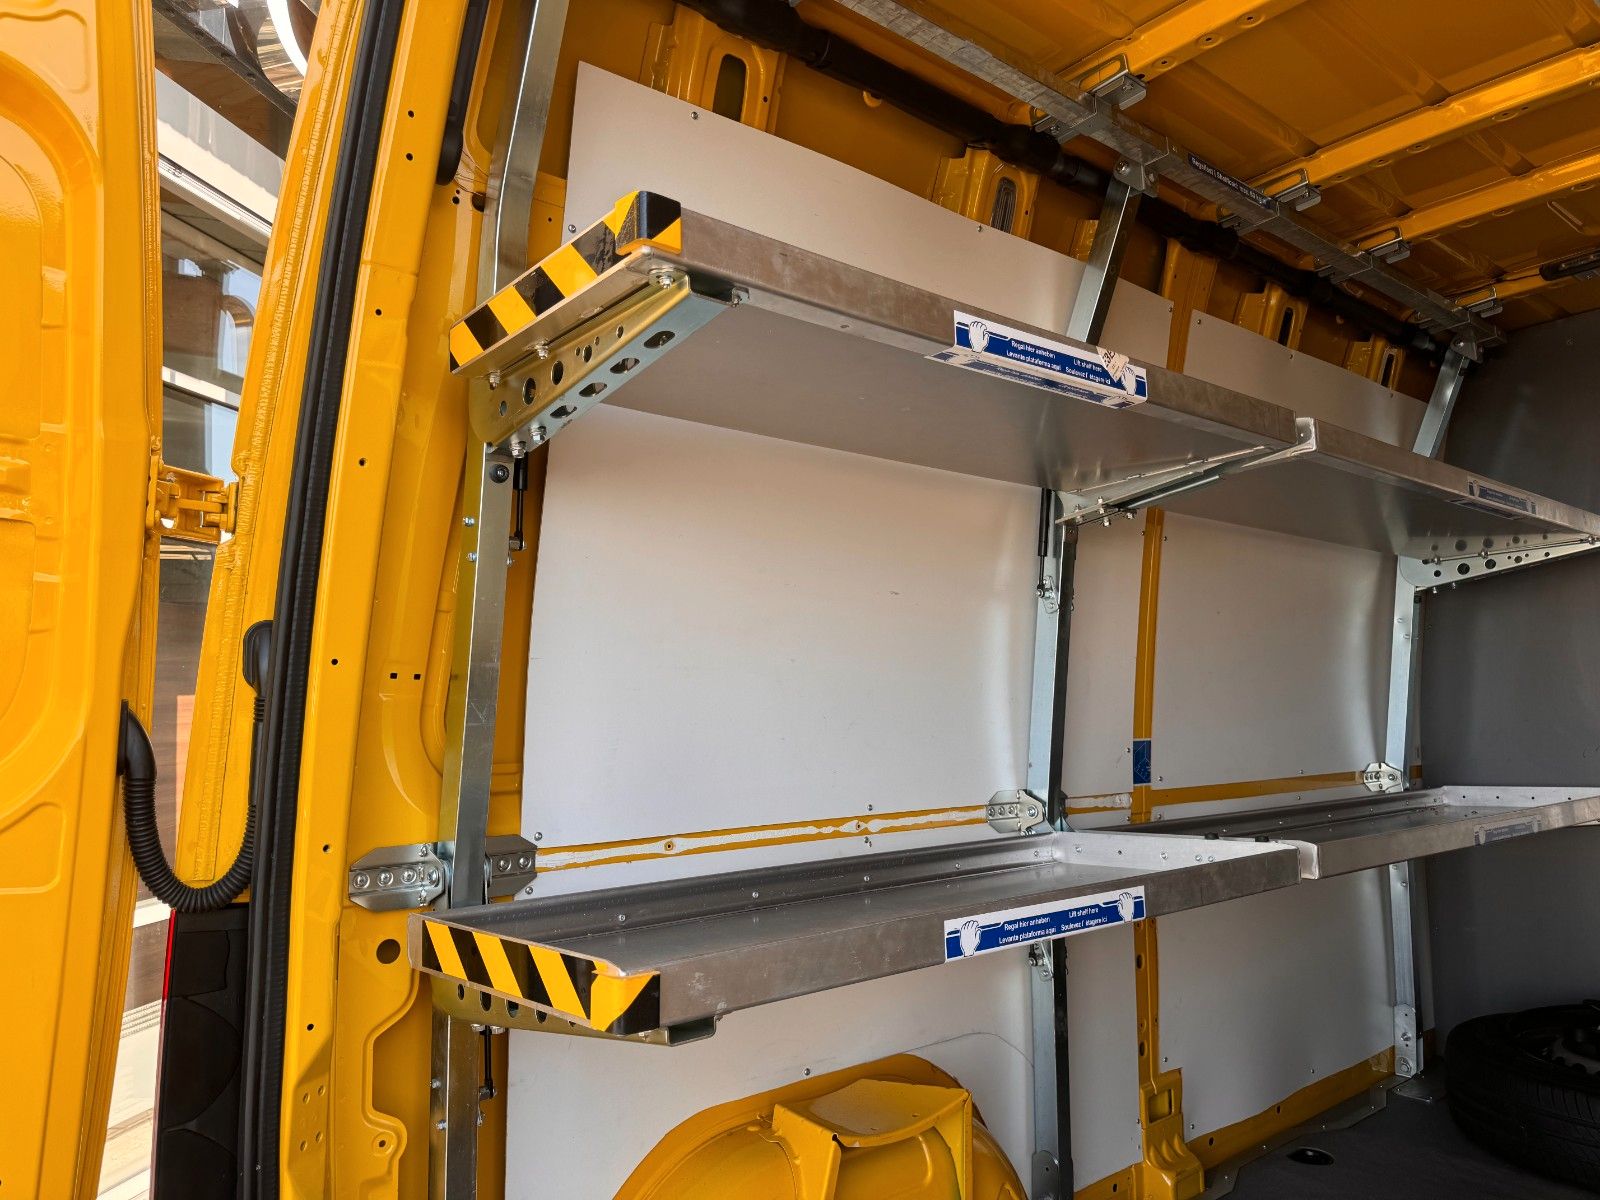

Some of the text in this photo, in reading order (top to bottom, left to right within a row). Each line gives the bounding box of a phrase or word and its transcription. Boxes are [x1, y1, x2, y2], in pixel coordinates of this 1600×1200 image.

[1011, 340, 1056, 359] Regal hier anheben
[1006, 350, 1025, 361] Levante
[1025, 356, 1051, 368] plataforma
[1073, 358, 1081, 366] Lift
[1092, 364, 1102, 373] here
[1068, 907, 1098, 918] Lift shelf here
[1004, 917, 1051, 931] Regal hier anheben
[1061, 922, 1081, 931] Soulevez
[998, 934, 1018, 944] Levante
[1019, 929, 1045, 941] plataforma
